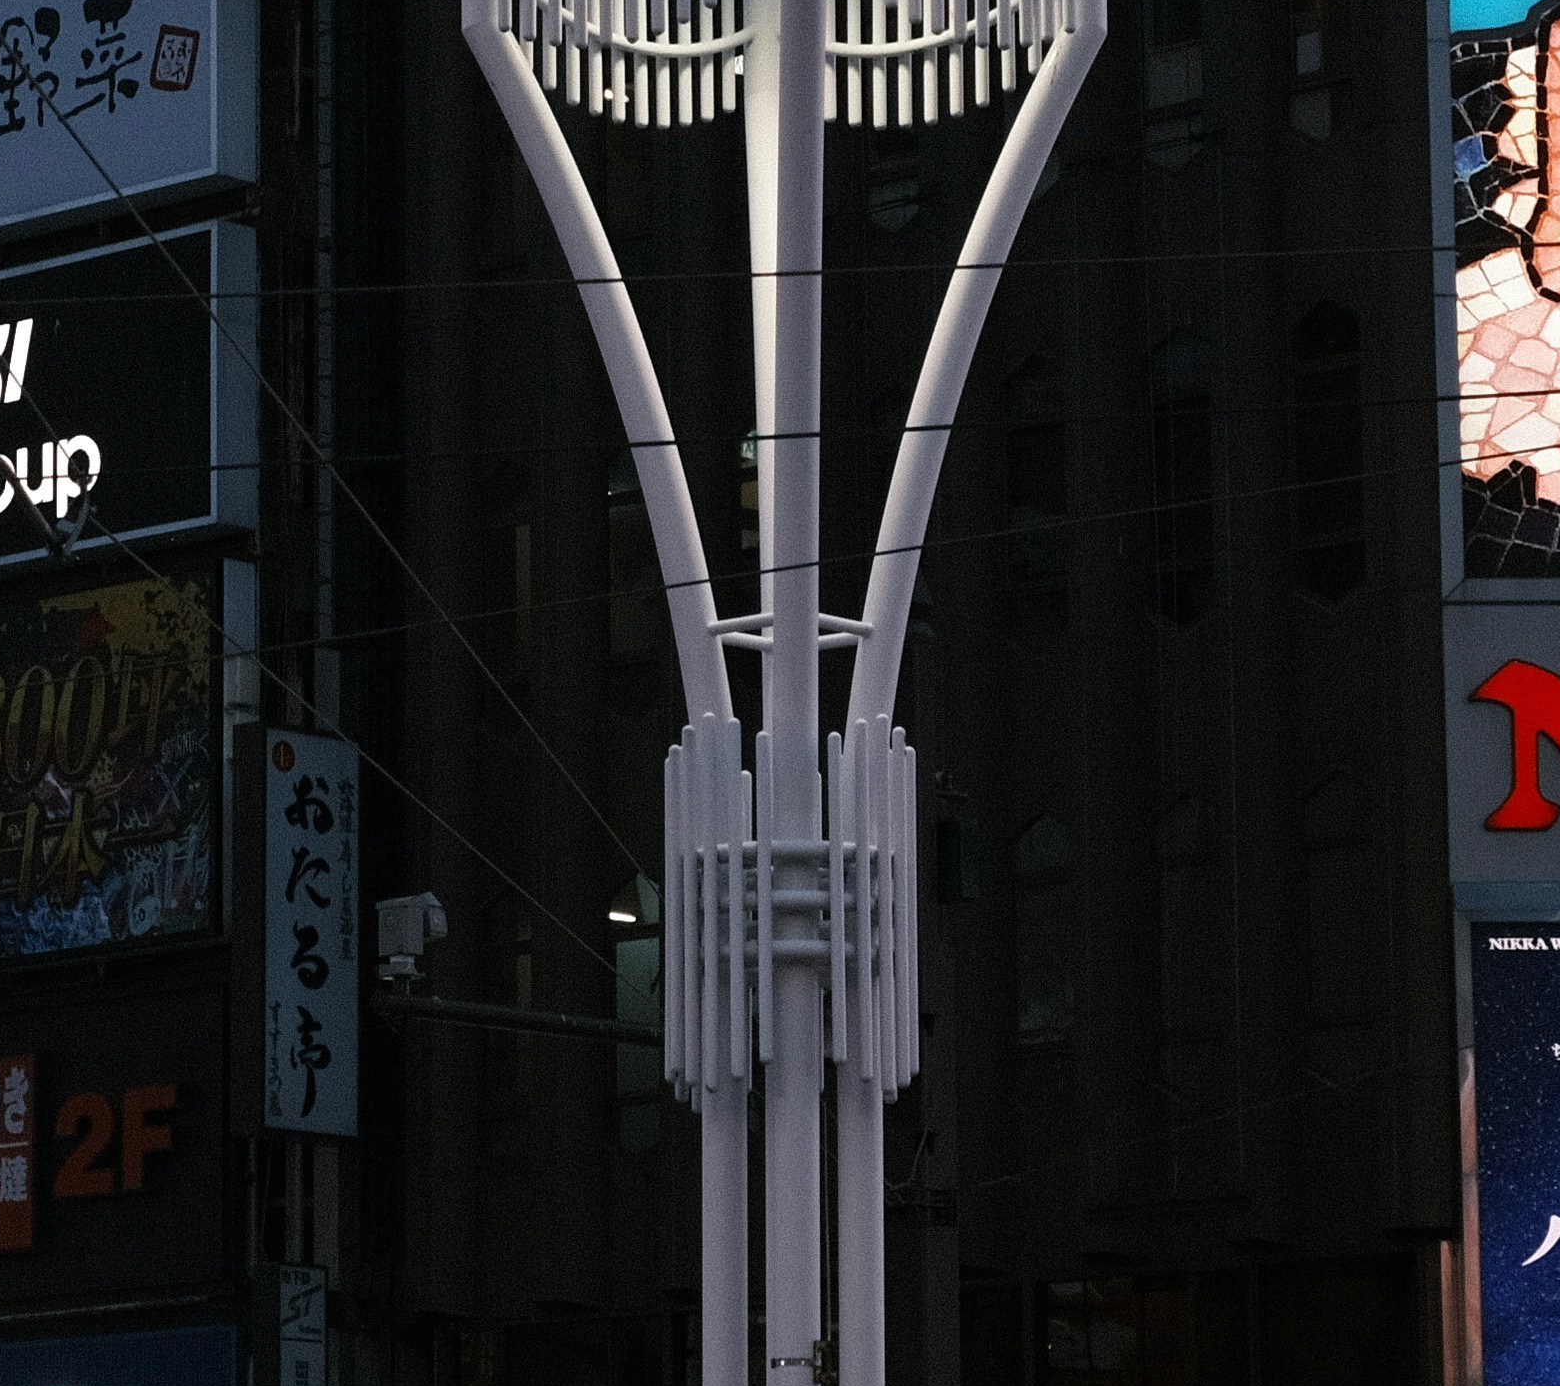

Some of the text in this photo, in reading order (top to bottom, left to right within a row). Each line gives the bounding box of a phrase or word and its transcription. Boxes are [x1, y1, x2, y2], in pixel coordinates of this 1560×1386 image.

[282, 775, 334, 1119] おたる亭
[1489, 938, 1548, 951] NIKKA
[54, 1086, 179, 1200] 2F
